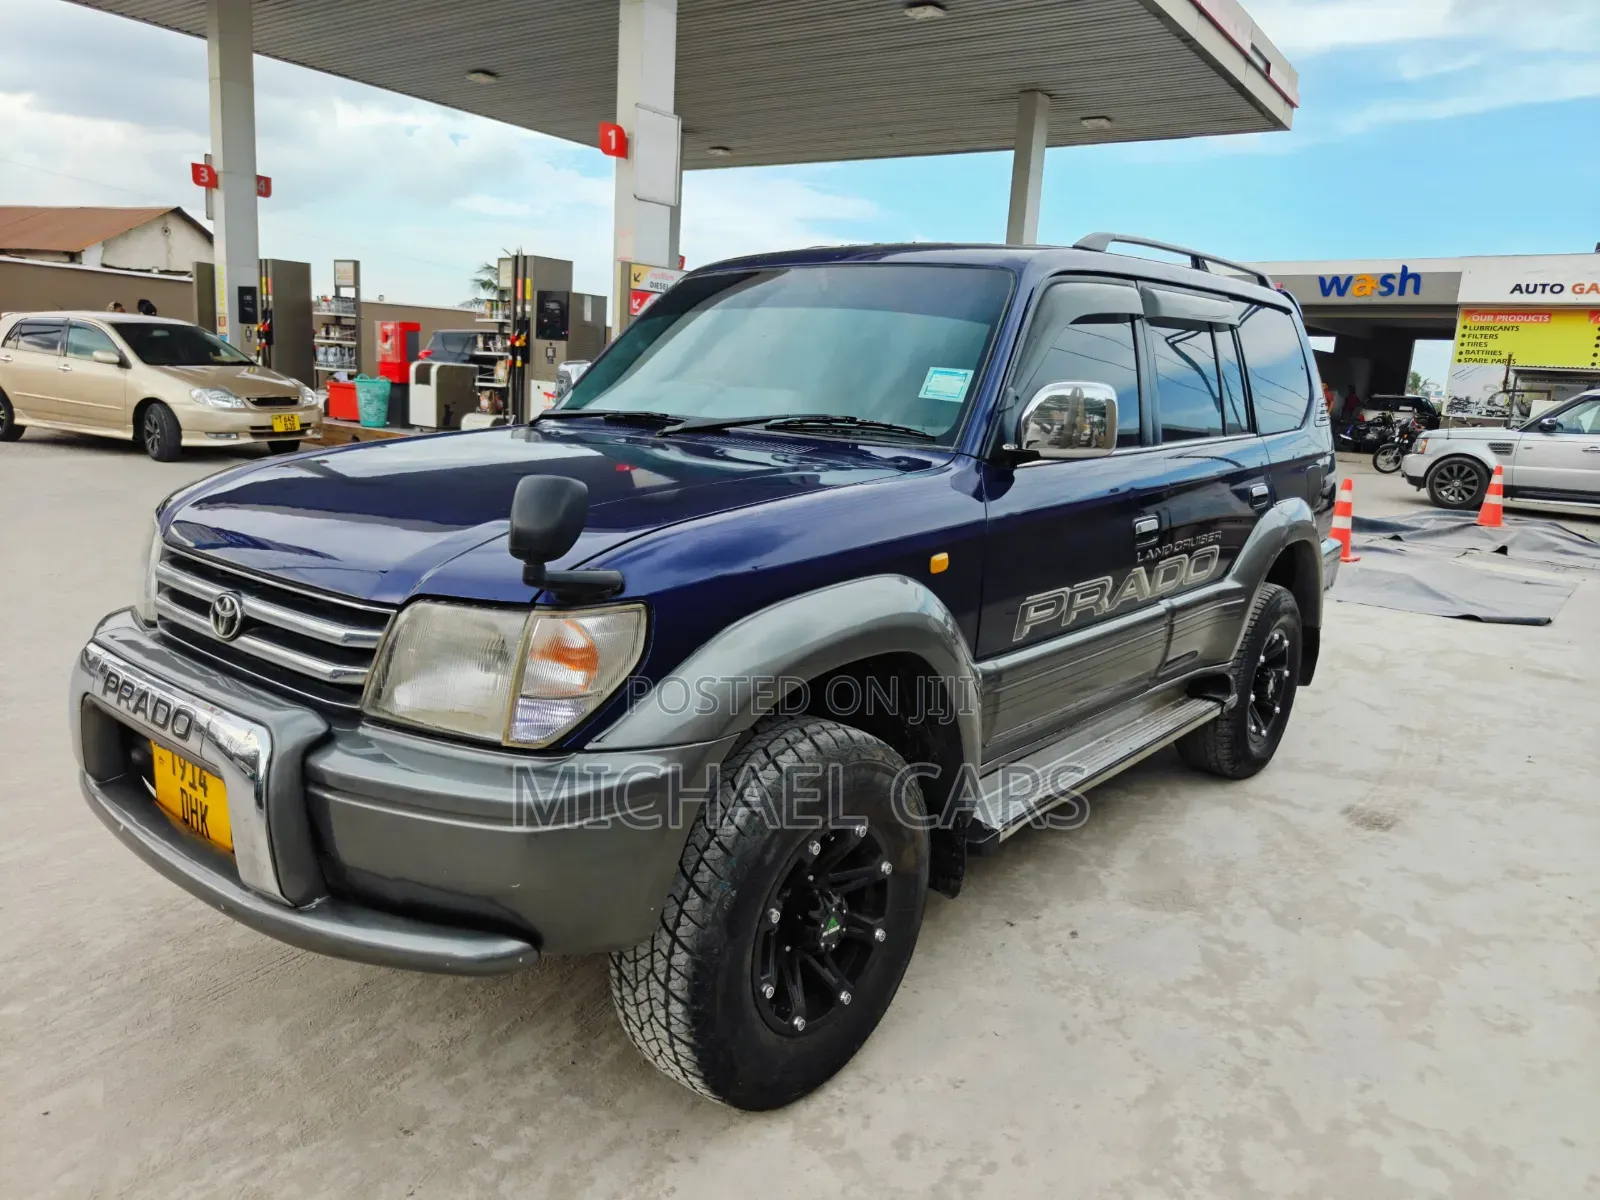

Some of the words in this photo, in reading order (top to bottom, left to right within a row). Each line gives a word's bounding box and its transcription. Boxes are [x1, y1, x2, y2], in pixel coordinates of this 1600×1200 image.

[608, 129, 616, 150] 1
[200, 167, 209, 183] 3
[257, 180, 266, 192] 4
[649, 281, 669, 290] DIESEL
[1318, 264, 1422, 297] wash
[1510, 283, 1565, 295] AUTO
[1472, 314, 1494, 322] OUR
[1496, 314, 1549, 323] PRODUCTS
[1012, 544, 1220, 642] PRADO
[102, 669, 196, 742] PRADO
[180, 786, 211, 839] DHK
